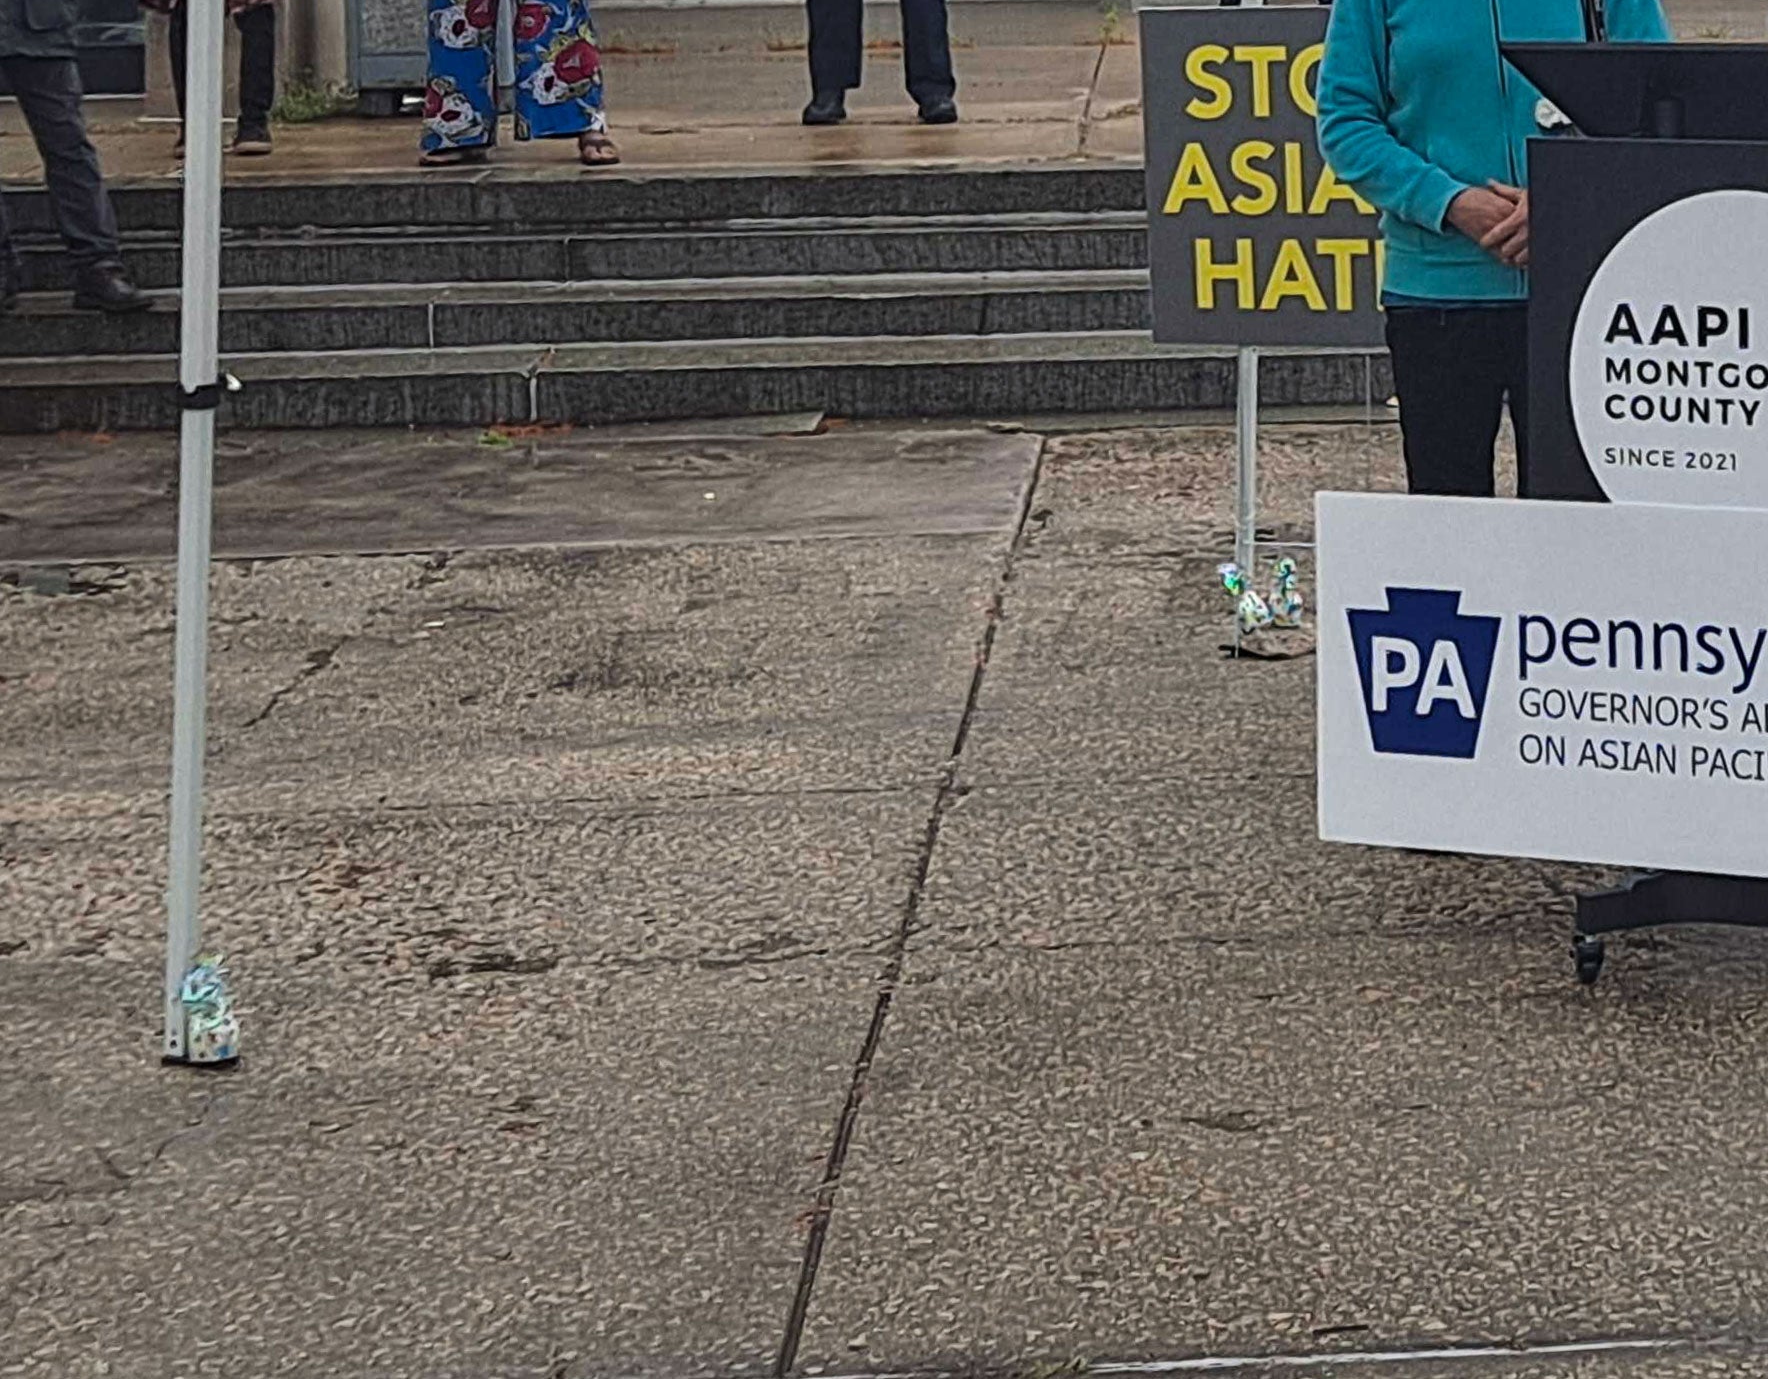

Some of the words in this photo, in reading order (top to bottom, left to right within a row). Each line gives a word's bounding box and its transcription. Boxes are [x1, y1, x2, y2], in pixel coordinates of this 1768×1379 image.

[1184, 43, 1326, 119] ST
[1163, 141, 1377, 216] ASIA
[1195, 237, 1386, 311] HAT
[1604, 303, 1750, 350] AAPI
[1604, 393, 1761, 426] COUNTY
[1604, 447, 1675, 468] SINCE
[1685, 451, 1737, 472] 2021
[1371, 635, 1477, 719] PA
[1518, 687, 1729, 730] GOVERNOR'S
[1518, 733, 1565, 767] ON
[1577, 738, 1677, 774] ASIAN
